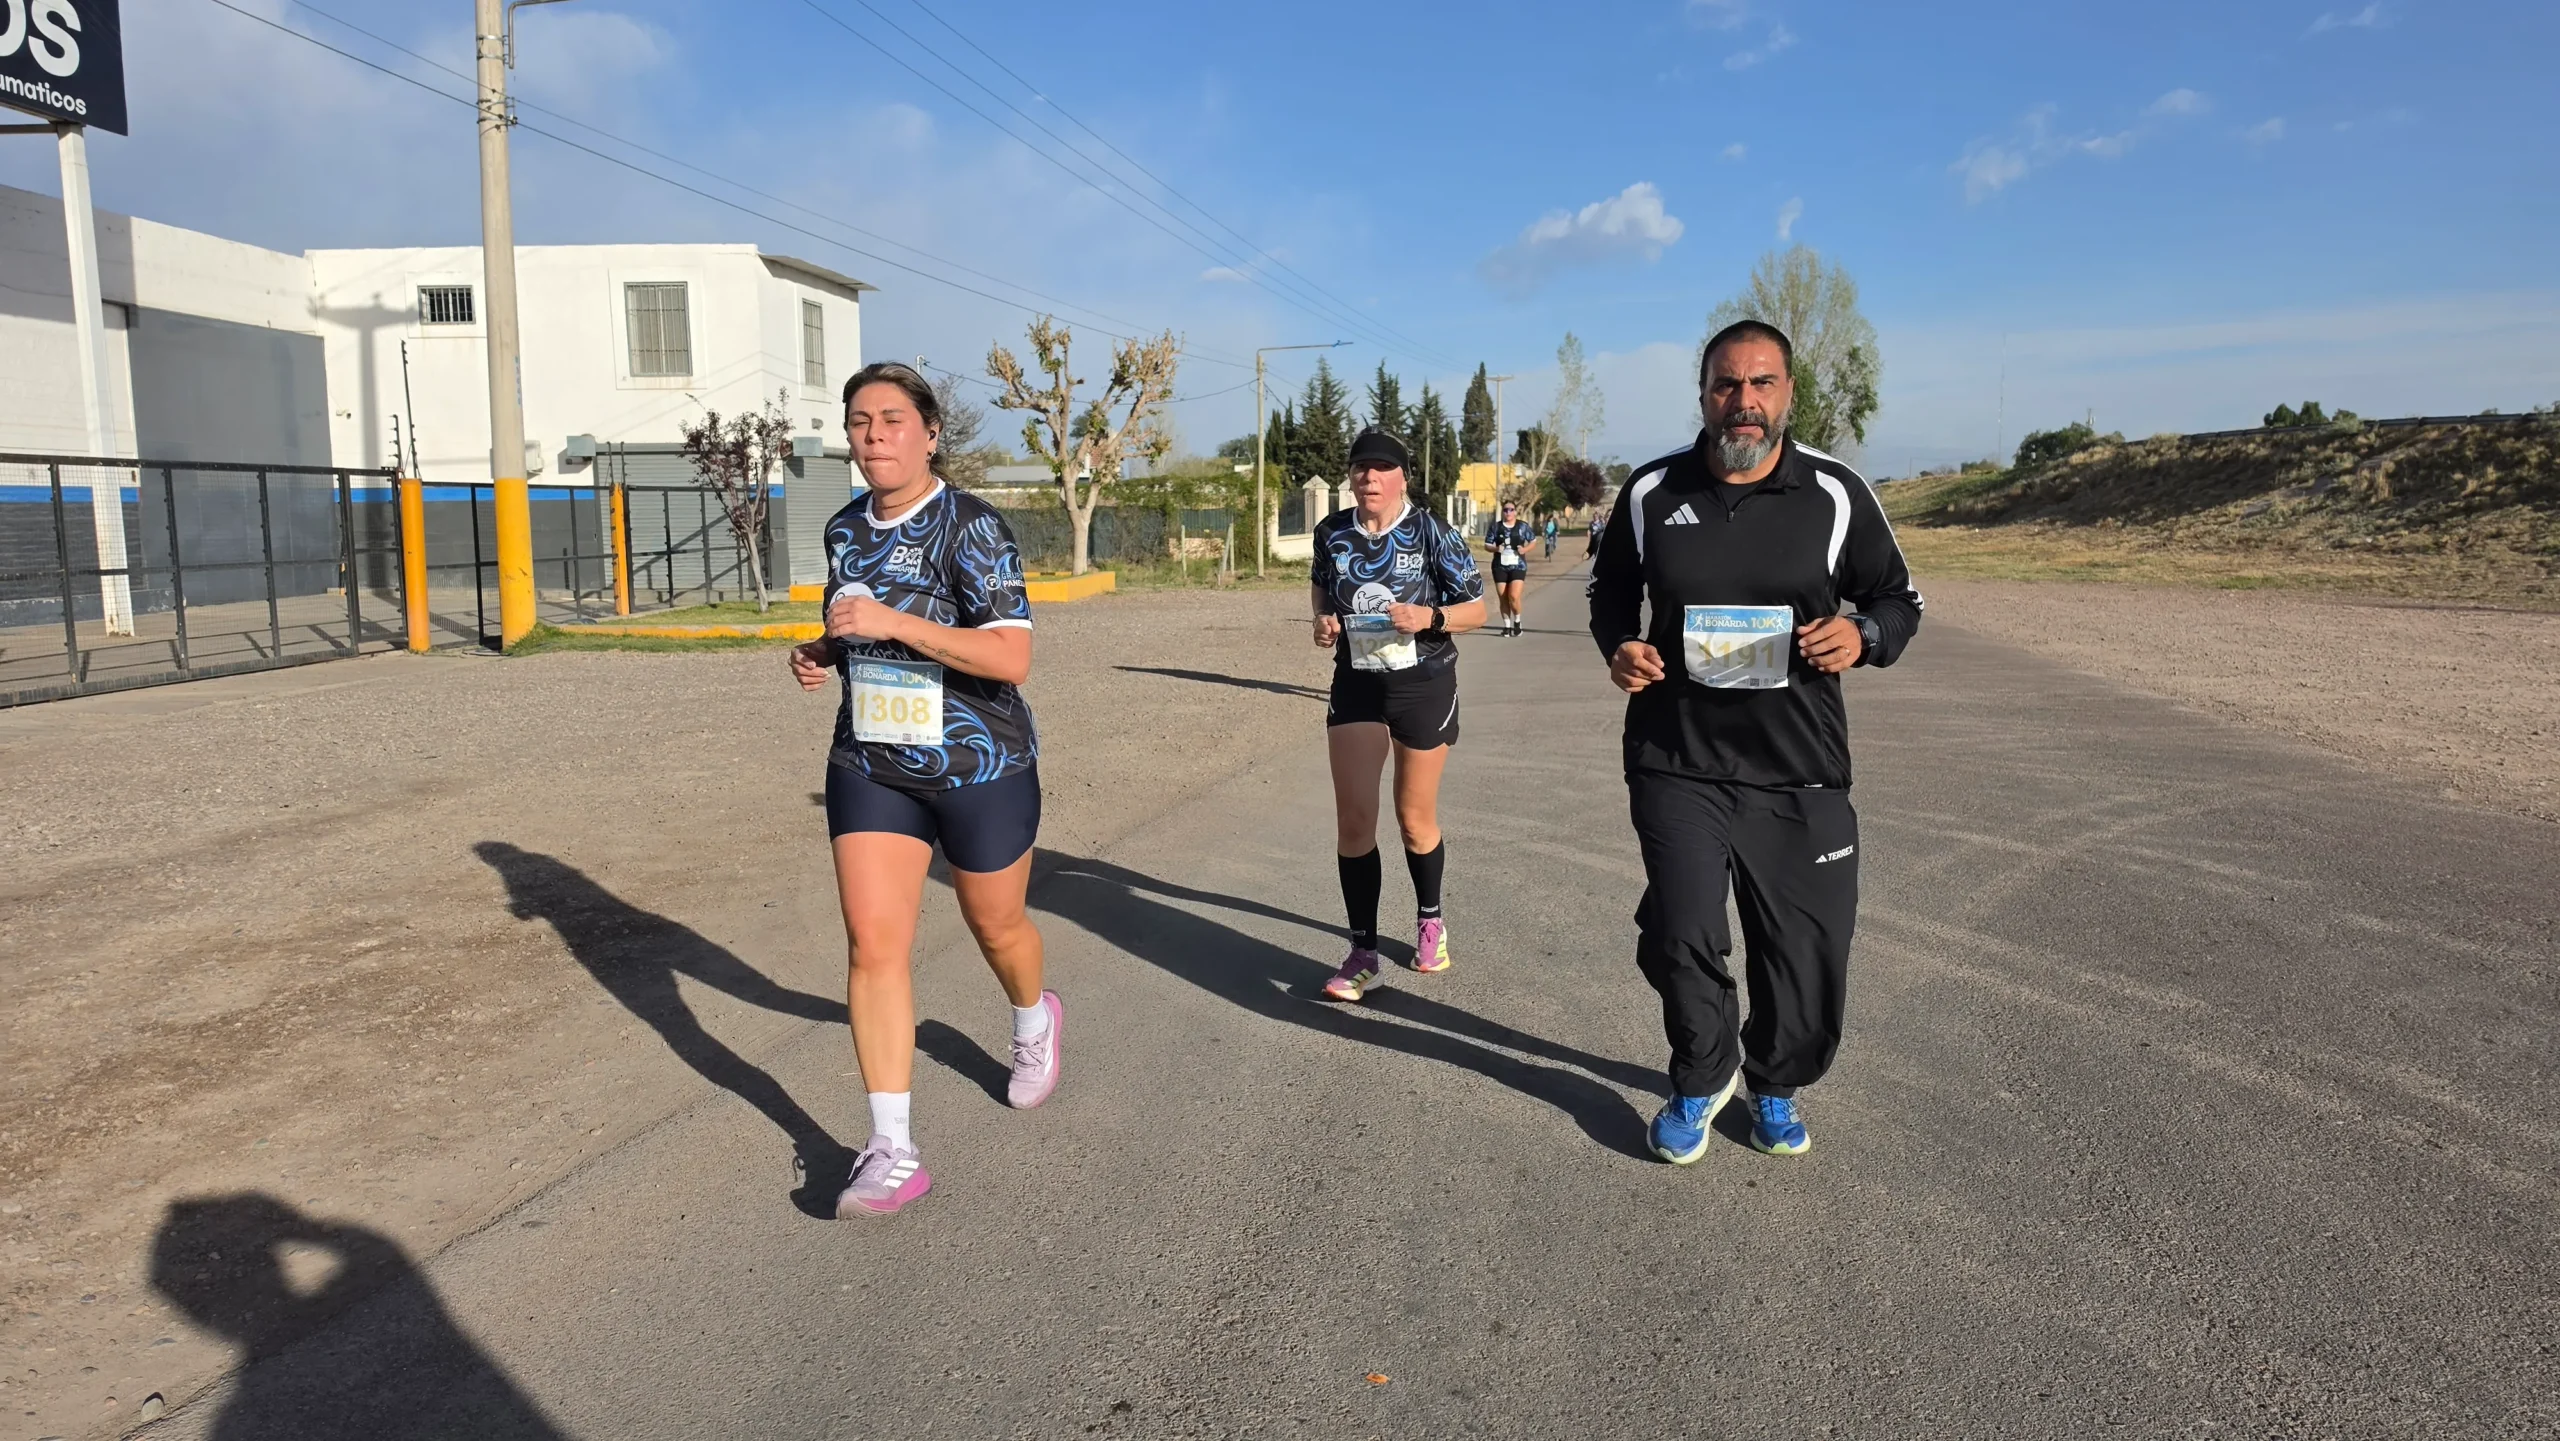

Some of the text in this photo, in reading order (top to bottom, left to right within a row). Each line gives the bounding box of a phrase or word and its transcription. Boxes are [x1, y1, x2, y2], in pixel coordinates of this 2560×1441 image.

[1705, 616, 1776, 629] BONARDA 10K
[863, 670, 924, 684] BONARDA 10K
[856, 691, 931, 724] 1308
[1827, 844, 1854, 861] TERREX
